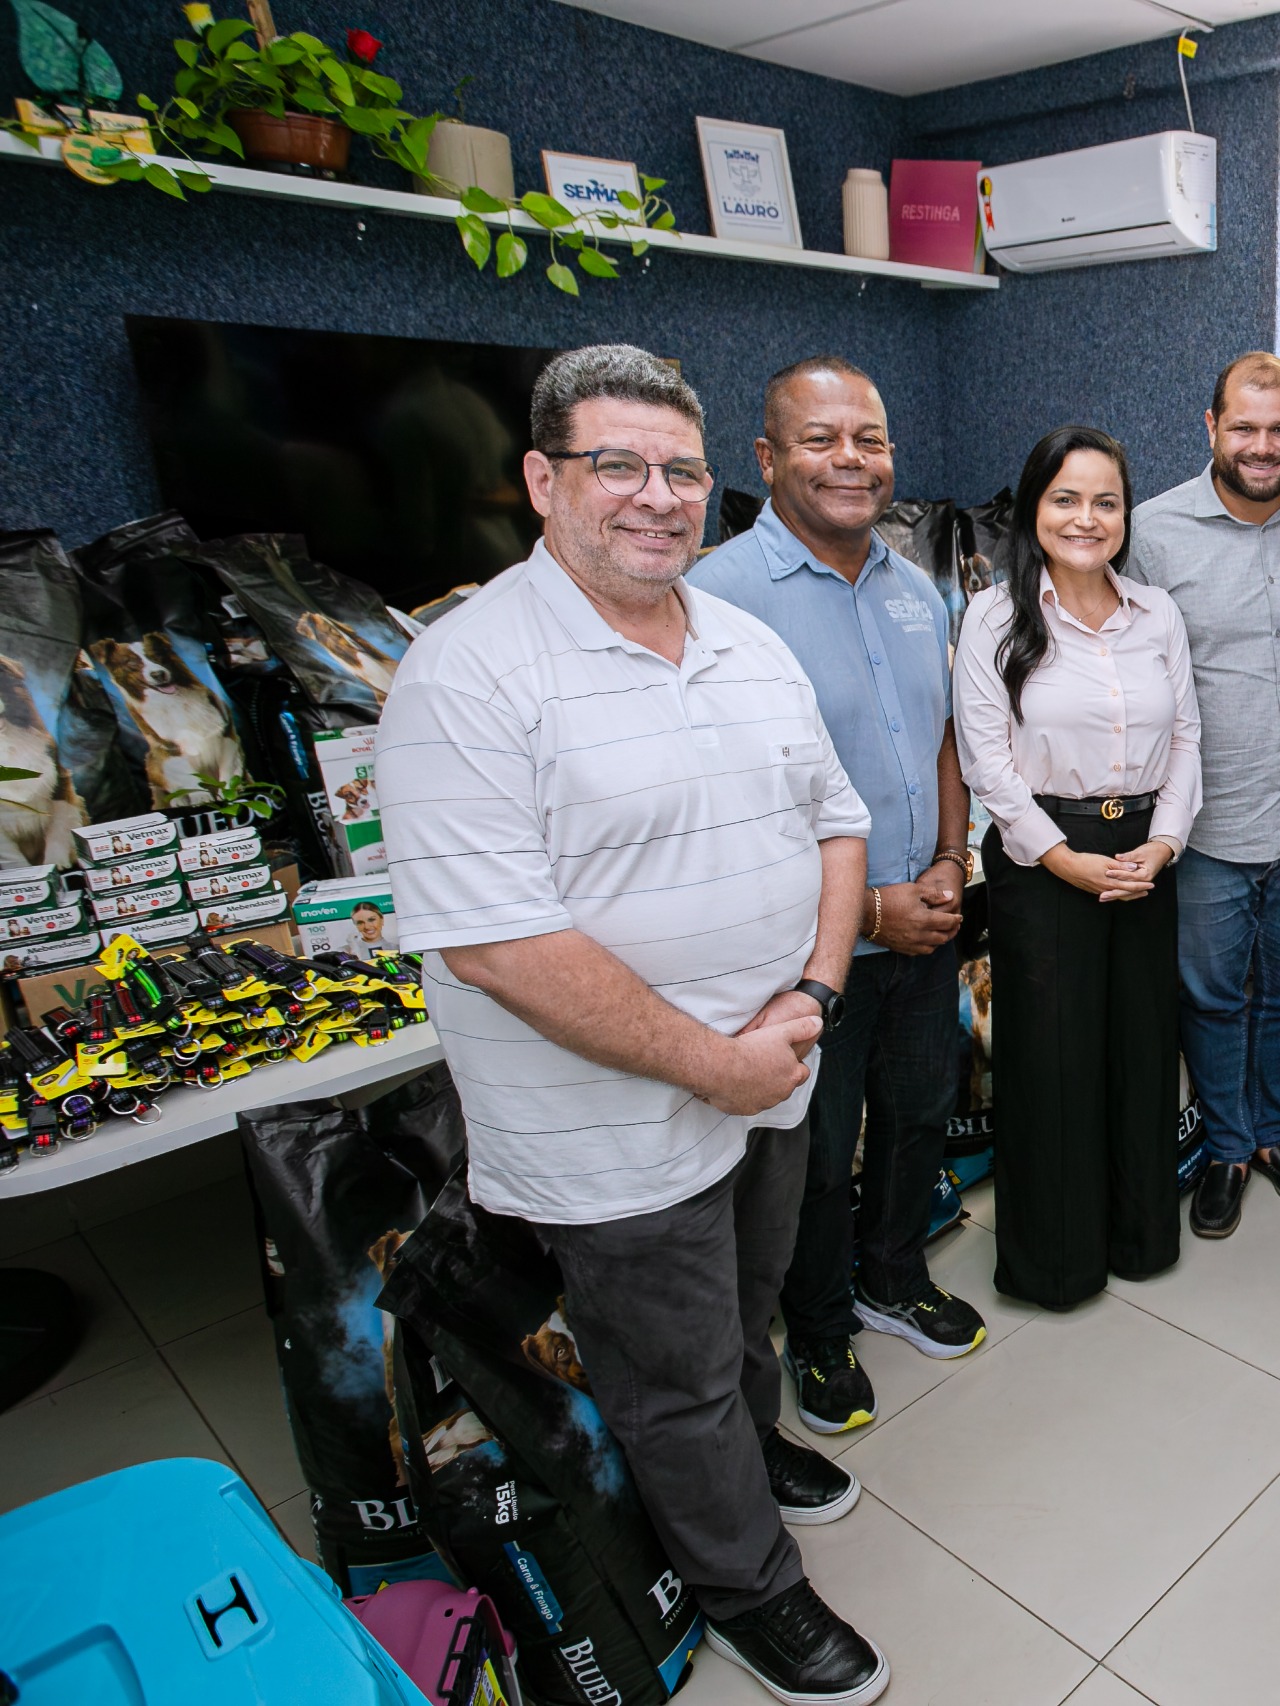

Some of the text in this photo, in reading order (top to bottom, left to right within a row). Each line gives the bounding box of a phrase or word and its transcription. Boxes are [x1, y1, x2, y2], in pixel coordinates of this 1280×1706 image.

[723, 201, 779, 219] LAURO
[901, 204, 960, 221] RESTINGA
[127, 827, 169, 841] Vetmax
[213, 842, 255, 855] Vetmax
[126, 859, 169, 872] Vetmax
[223, 870, 264, 883] Vetmax
[0, 885, 42, 896] etmax
[132, 888, 175, 902] Vetmax
[226, 897, 280, 912] Mebendazole
[24, 911, 73, 925] Vetmax
[131, 916, 190, 933] Mebendazole
[307, 925, 326, 934] 100
[26, 937, 91, 955] Mebendazole
[311, 942, 331, 953] PO
[508, 1480, 516, 1496] Peso
[495, 1481, 512, 1525] 15kg
[517, 1557, 554, 1620] Carne & Frango
